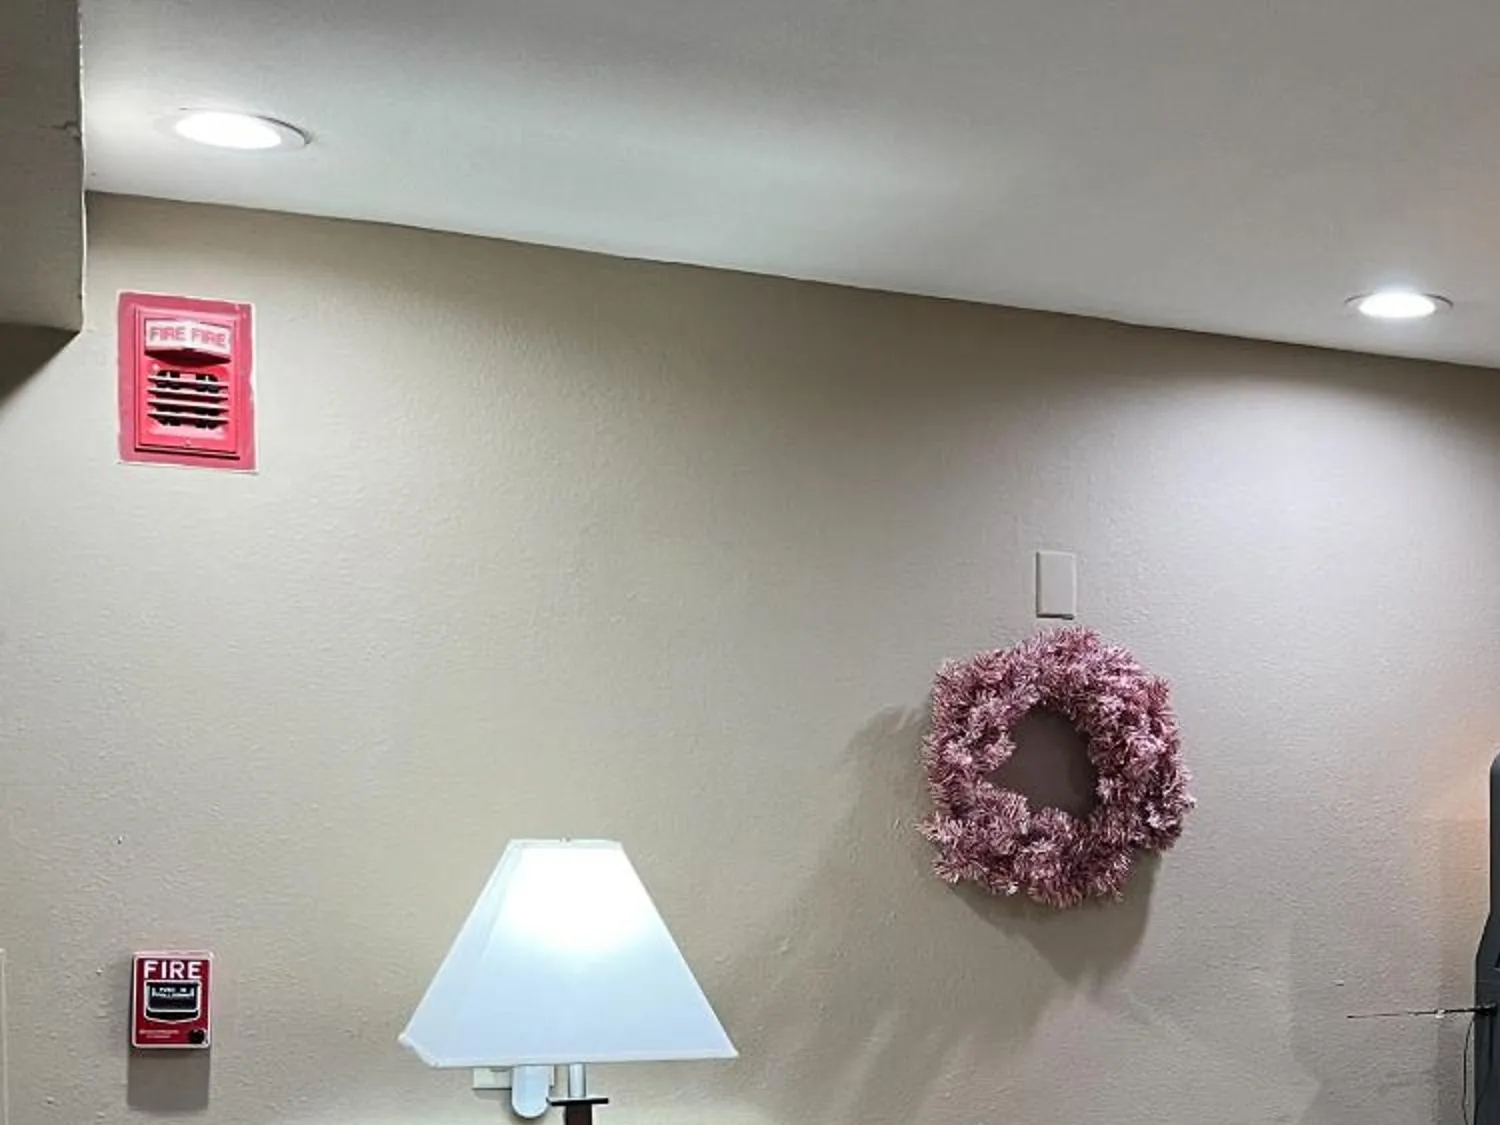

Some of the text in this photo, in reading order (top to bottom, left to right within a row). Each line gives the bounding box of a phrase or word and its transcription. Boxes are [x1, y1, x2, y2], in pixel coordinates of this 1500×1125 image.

[150, 325, 227, 350] FIRE FIRE
[143, 960, 203, 979] FIRE
